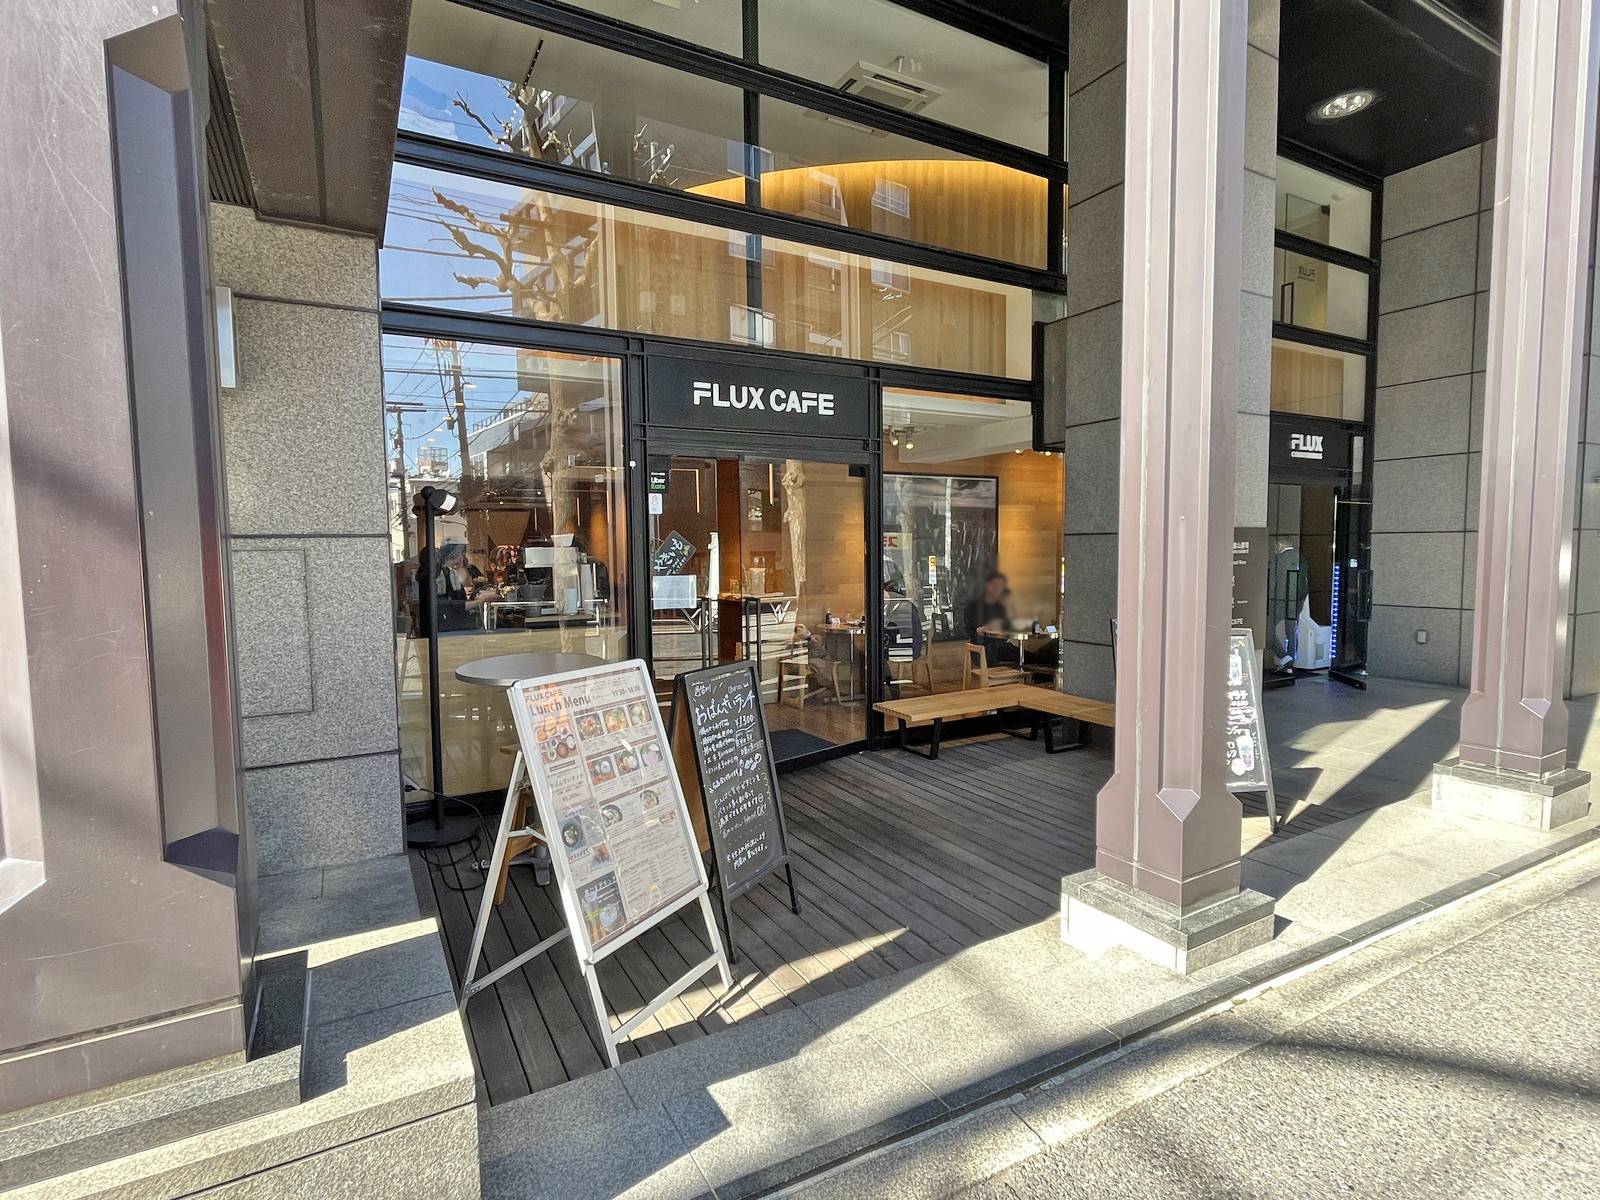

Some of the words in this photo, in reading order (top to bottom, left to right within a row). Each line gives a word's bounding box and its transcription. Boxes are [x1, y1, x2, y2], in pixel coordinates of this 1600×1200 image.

[693, 381, 765, 410] FLUX
[769, 388, 835, 416] CAFE
[1291, 433, 1324, 452] FLUX
[525, 692, 544, 703] FLUX
[545, 689, 563, 699] CAFE
[529, 699, 562, 717] Lunch
[563, 695, 591, 710] Menu
